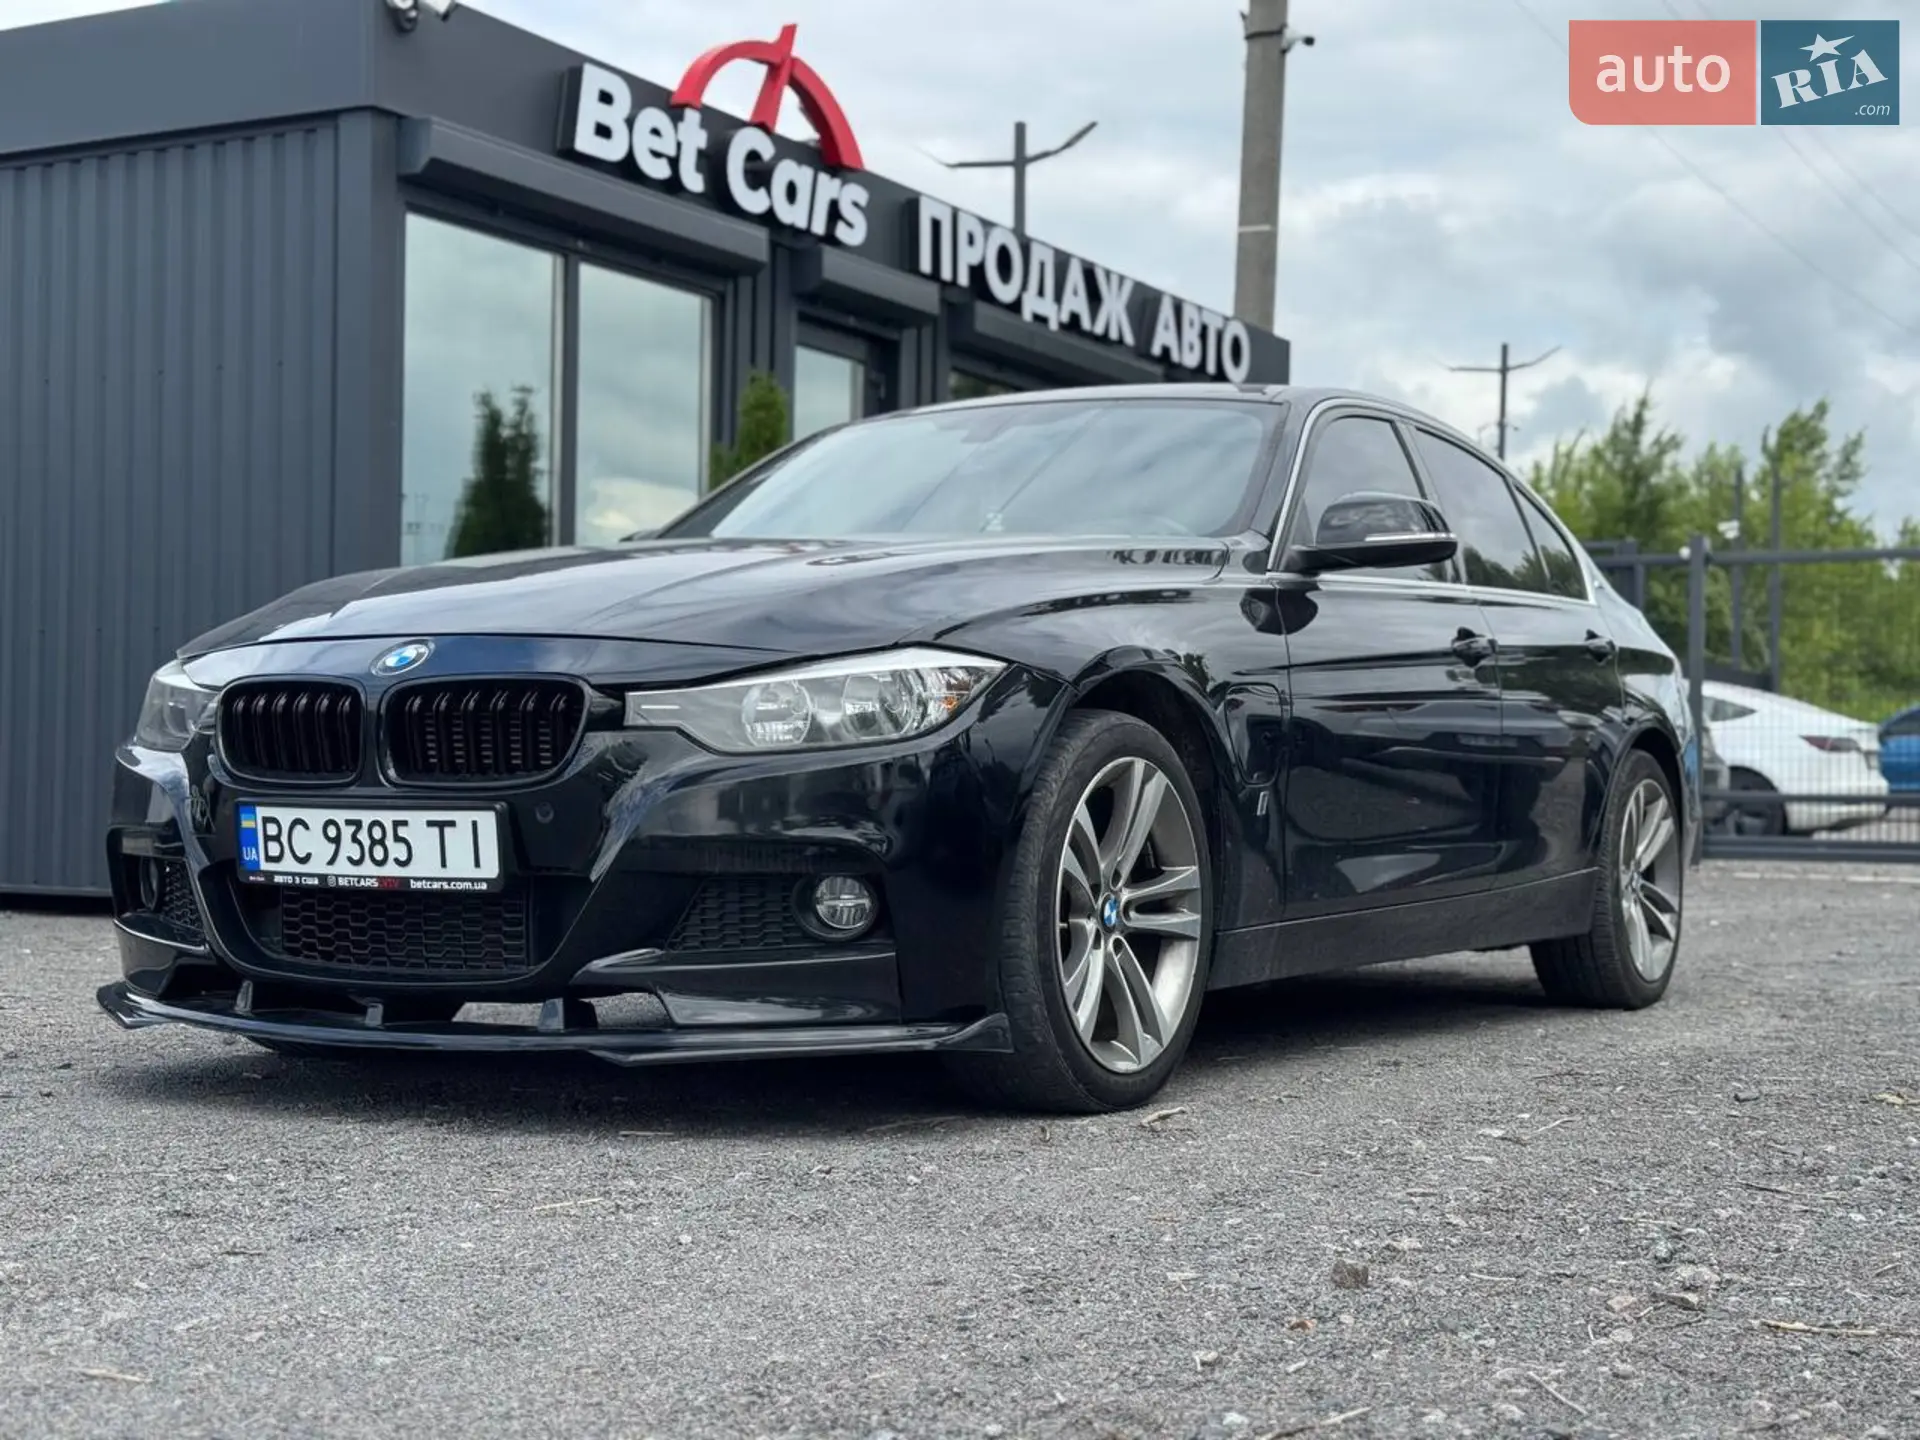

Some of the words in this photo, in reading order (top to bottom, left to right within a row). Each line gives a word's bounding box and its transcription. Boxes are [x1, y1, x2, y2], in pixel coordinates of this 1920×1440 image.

[574, 62, 708, 193] Bet
[726, 125, 869, 246] Cars
[917, 195, 1135, 347] ПРОДАЖ
[1150, 294, 1251, 383] АВТО
[242, 846, 259, 861] UA
[261, 815, 313, 865] BC
[322, 818, 413, 868] 9385
[425, 819, 481, 869] TI
